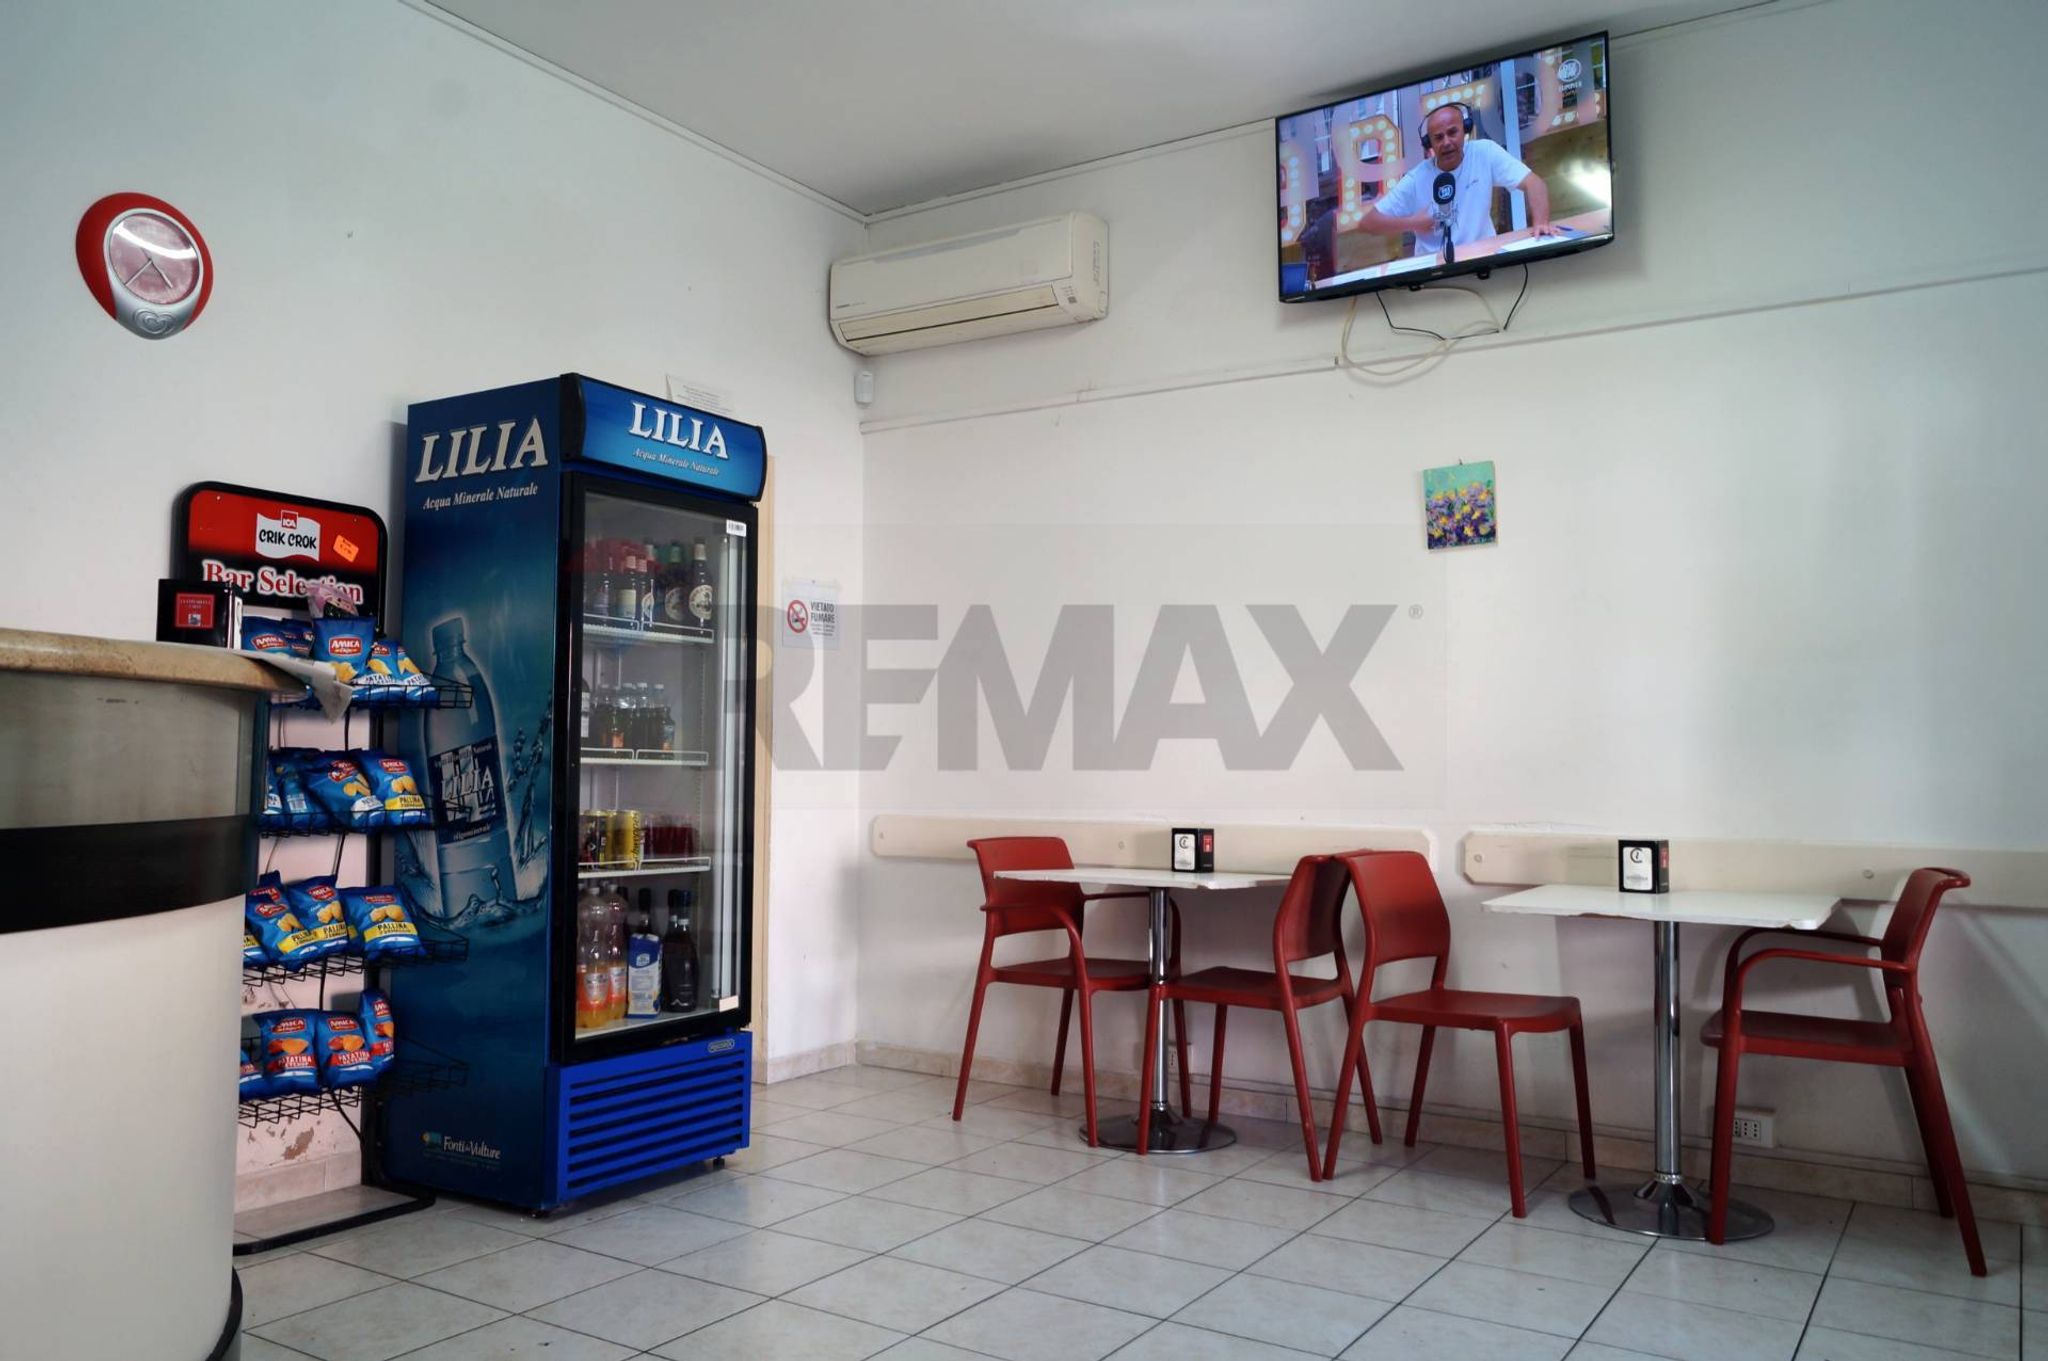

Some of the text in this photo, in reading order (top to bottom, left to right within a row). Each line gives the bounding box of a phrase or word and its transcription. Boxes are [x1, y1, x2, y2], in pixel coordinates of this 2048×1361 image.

[629, 402, 728, 459] LILIA
[415, 416, 548, 482] LILIA
[633, 448, 656, 463] Acqua
[423, 481, 539, 511] Acqua Minerale Naturale
[259, 529, 286, 545] CRIK
[288, 533, 317, 549] CROK
[811, 601, 834, 613] VIETATO
[811, 612, 835, 624] FUMARE
[331, 640, 360, 648] AMICA
[443, 1135, 464, 1152] Fonti
[470, 1141, 500, 1159] Vulture
